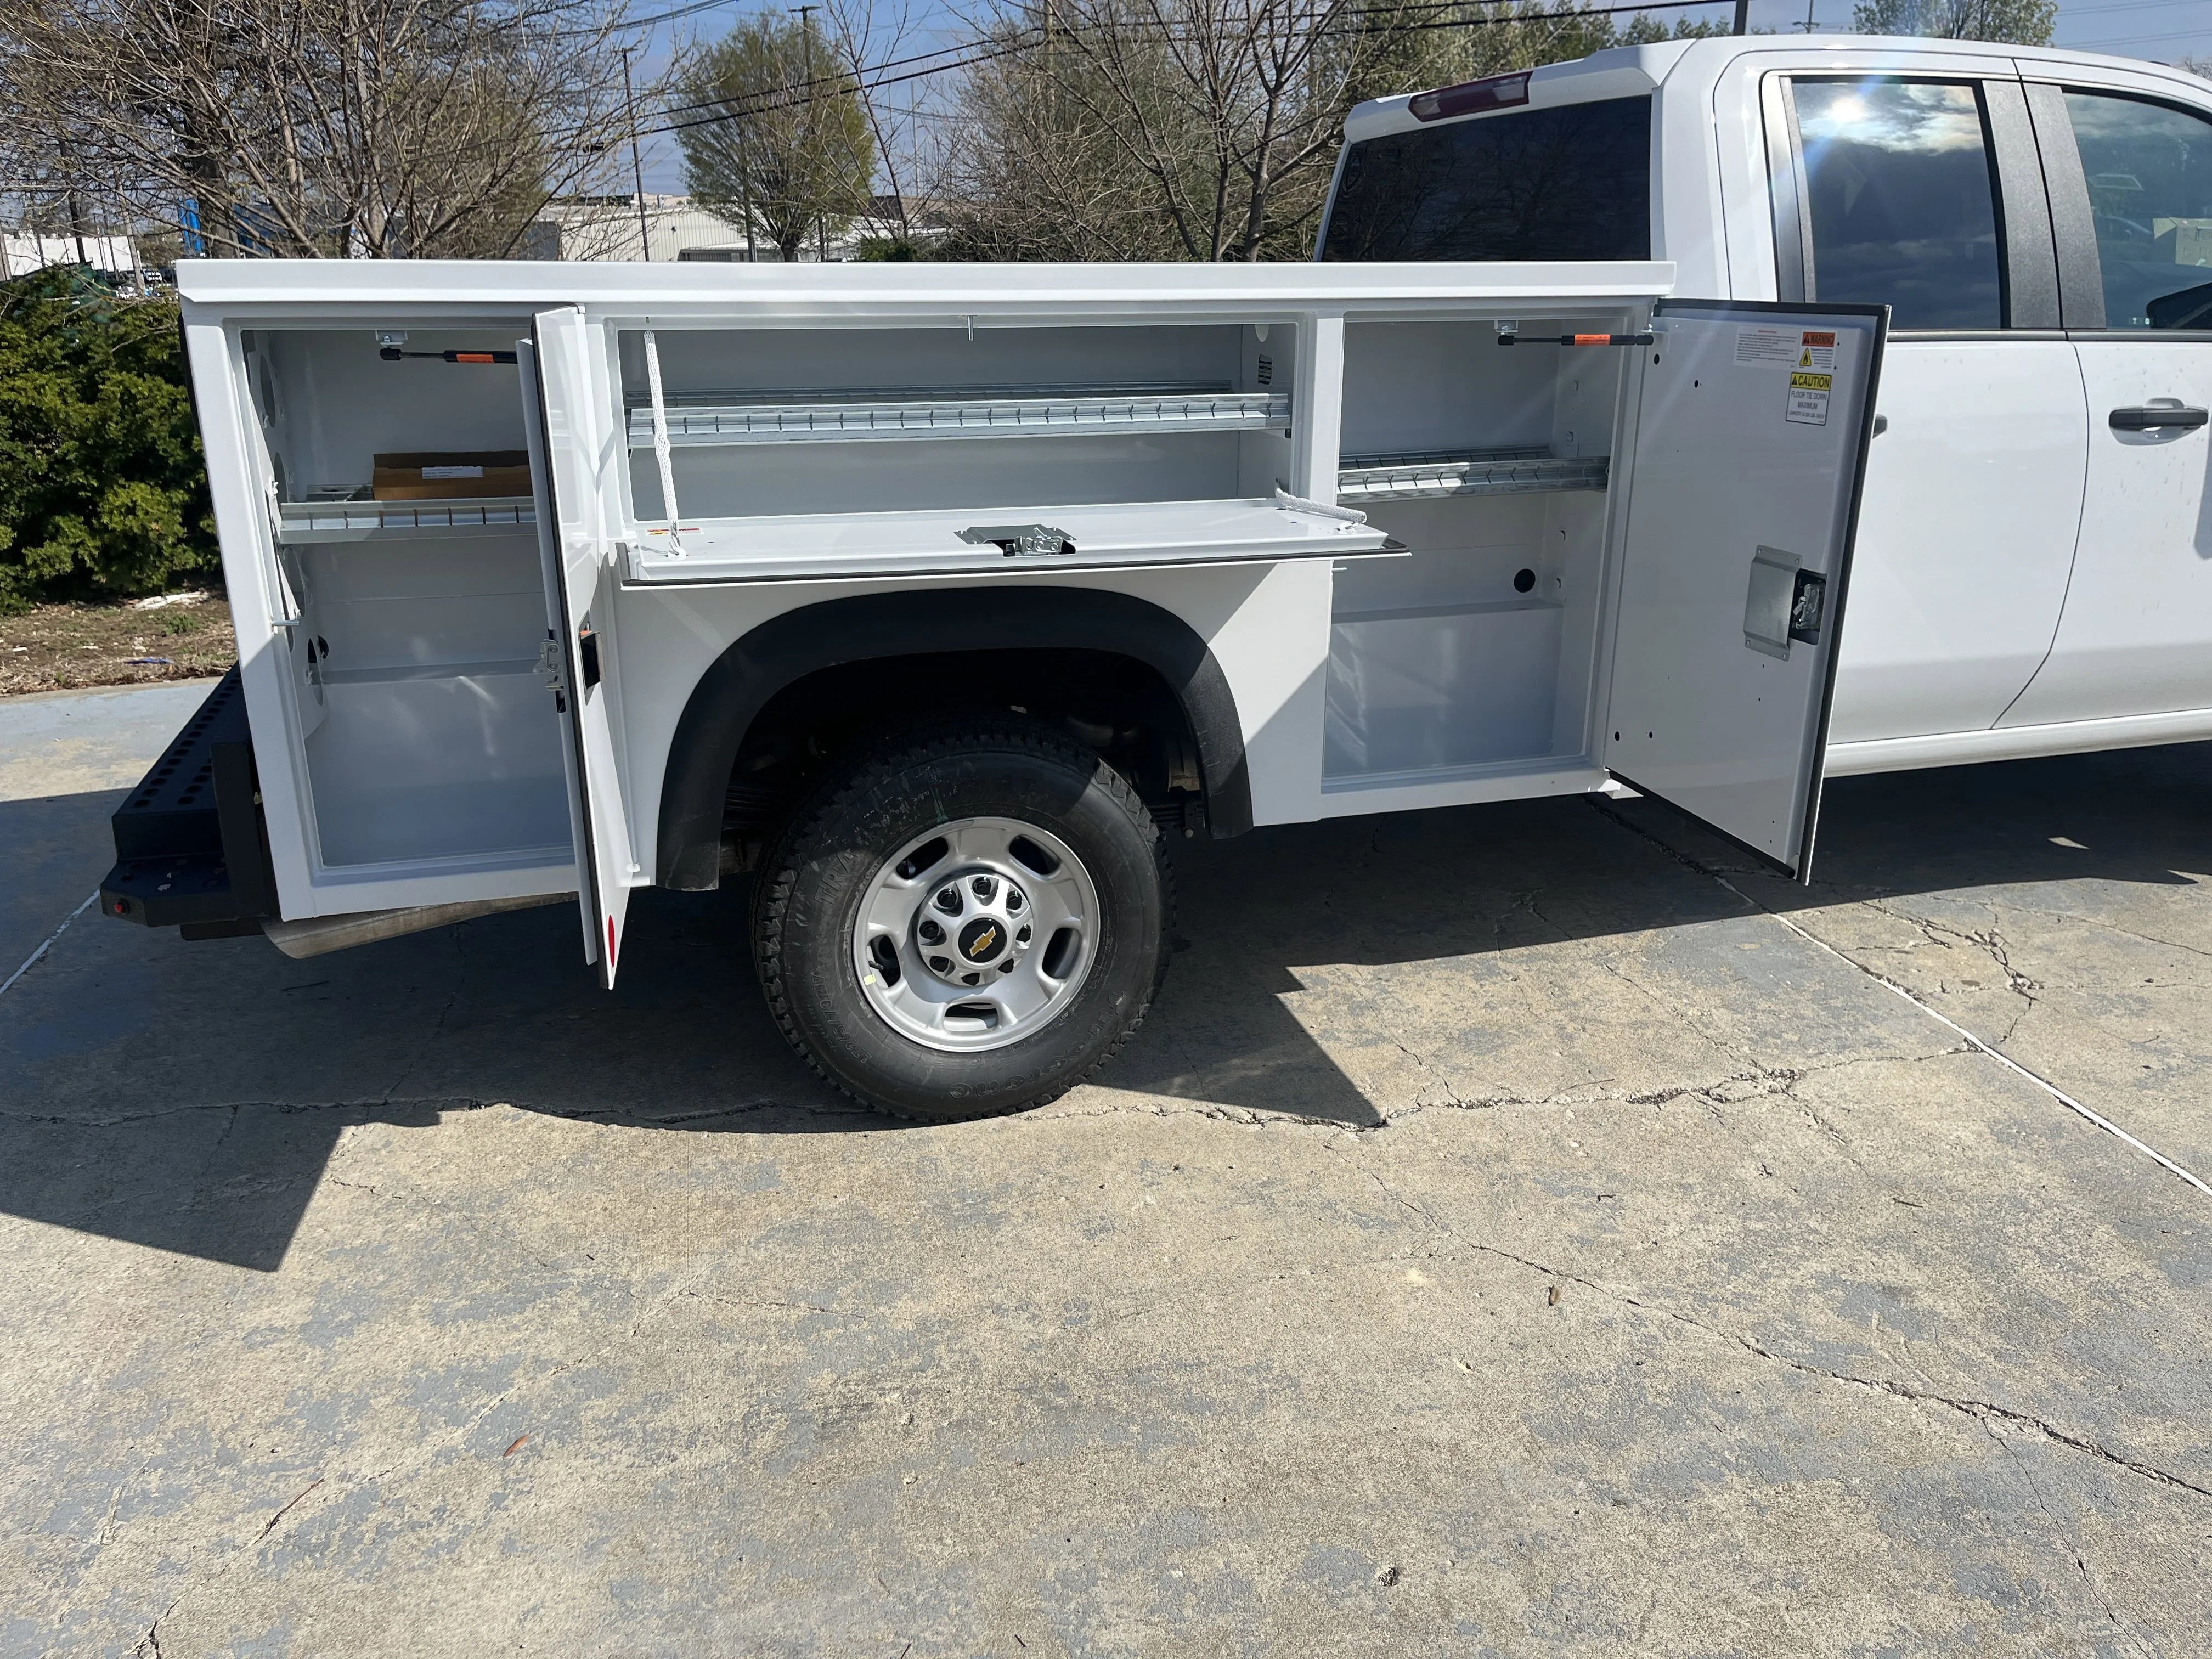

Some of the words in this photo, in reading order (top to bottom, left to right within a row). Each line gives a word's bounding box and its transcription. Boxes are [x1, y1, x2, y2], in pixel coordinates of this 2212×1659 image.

[1810, 334, 1834, 345] WARNING
[1798, 375, 1829, 387] CAUTION
[1791, 390, 1805, 398] FLOOR
[1798, 401, 1818, 409] MAXIMUM
